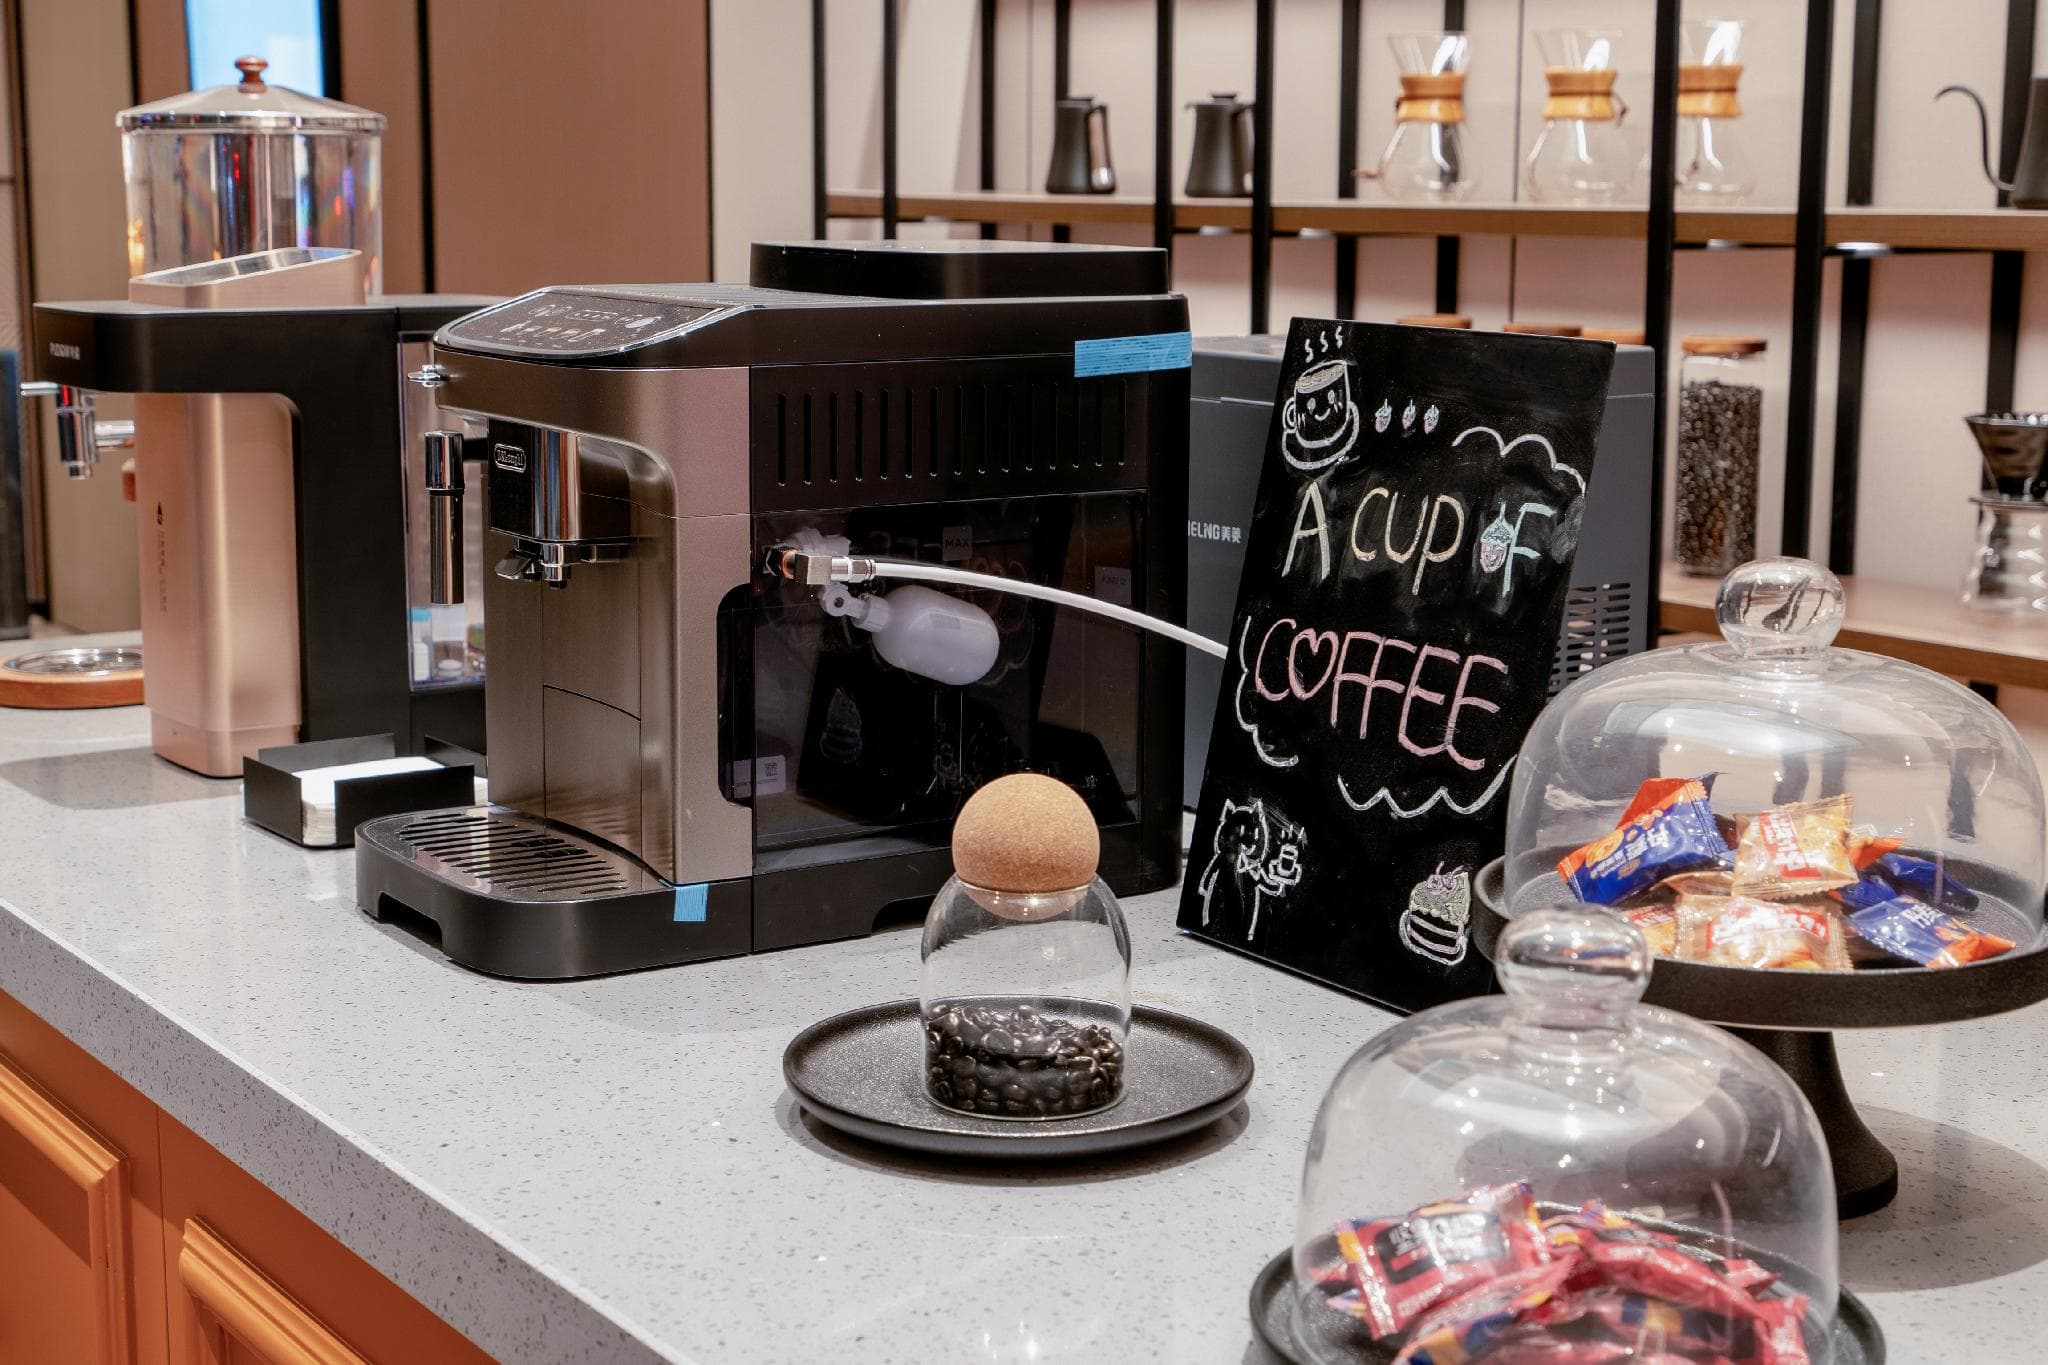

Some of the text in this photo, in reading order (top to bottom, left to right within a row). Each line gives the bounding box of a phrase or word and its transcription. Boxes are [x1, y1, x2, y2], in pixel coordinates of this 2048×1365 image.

[945, 536, 969, 549] MAX
[1281, 481, 1332, 582] A
[1254, 617, 1509, 771] COFFEE
